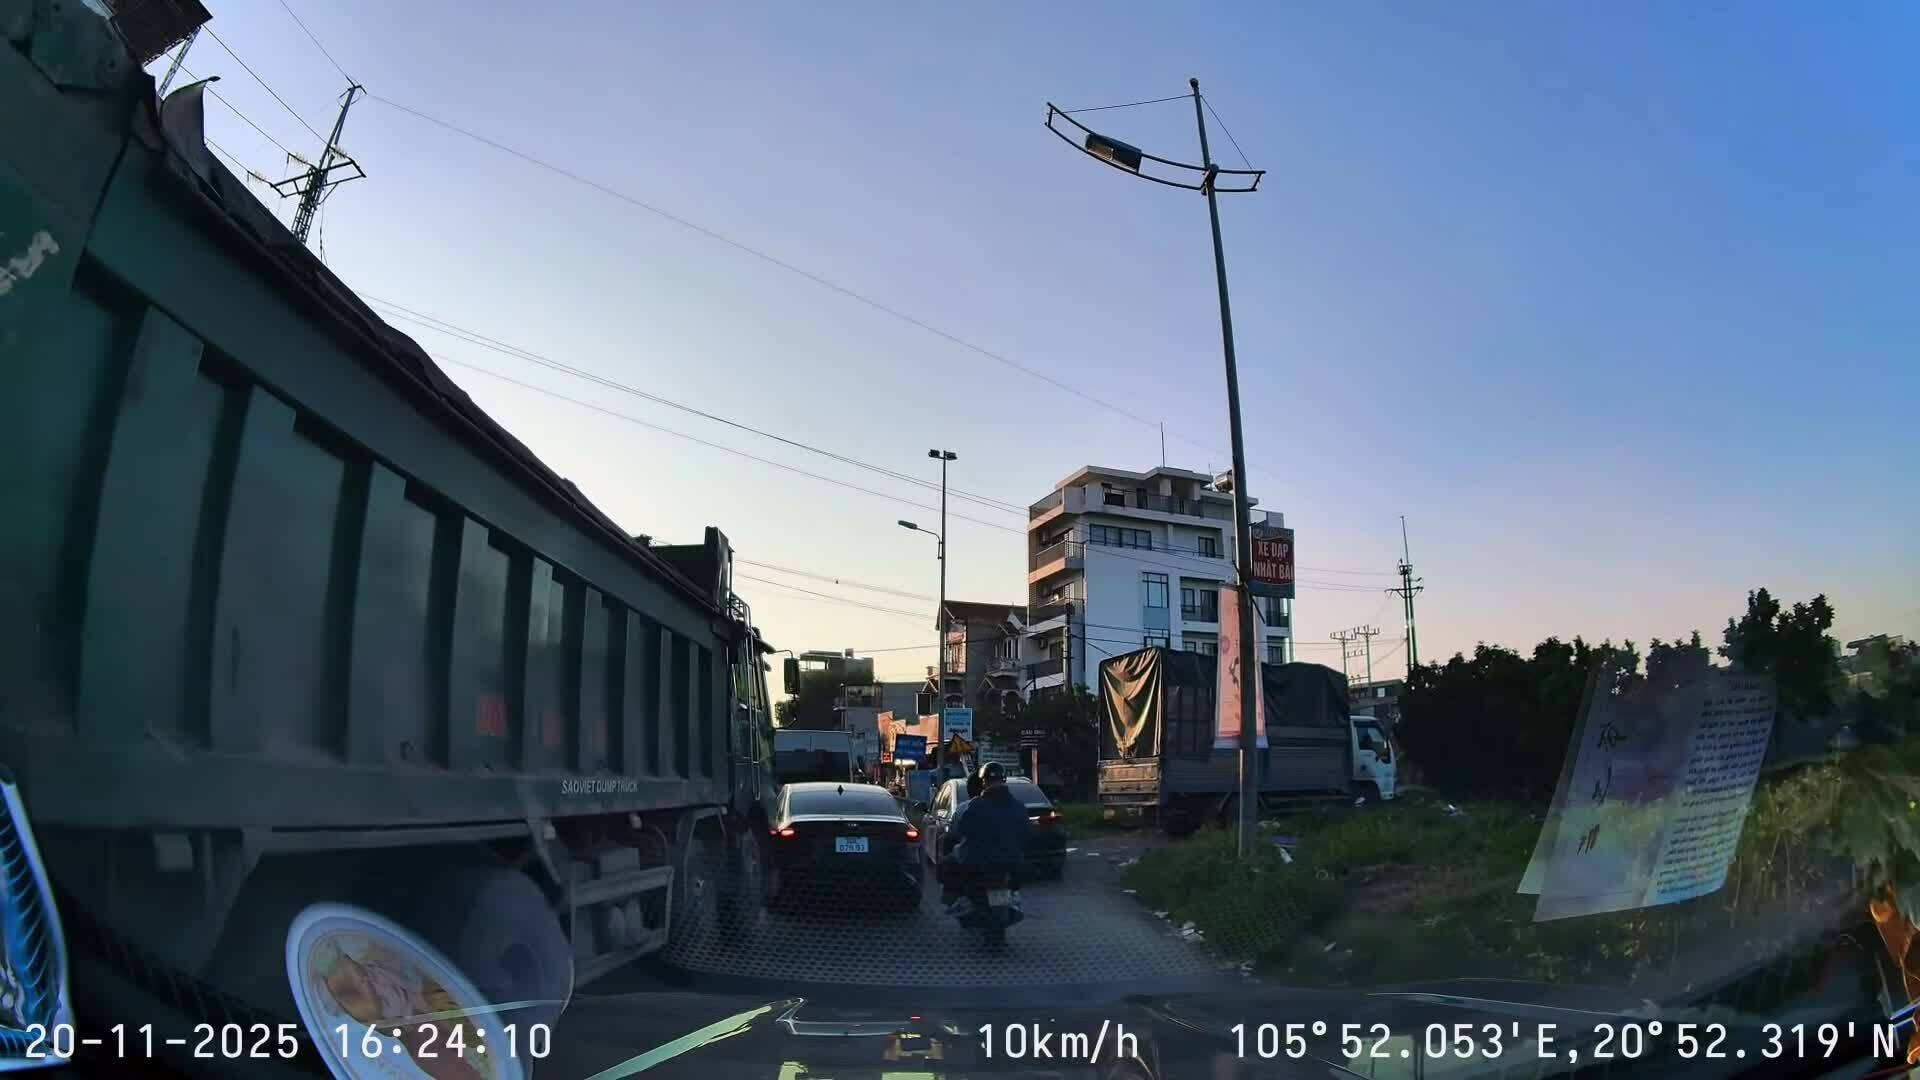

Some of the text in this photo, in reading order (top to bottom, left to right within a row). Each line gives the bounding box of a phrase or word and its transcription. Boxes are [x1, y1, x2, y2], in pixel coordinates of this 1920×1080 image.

[1257, 541, 1270, 557] XE
[1253, 559, 1277, 581] NHẬT
[597, 780, 616, 793] DUMP
[617, 780, 639, 793] TRUCK
